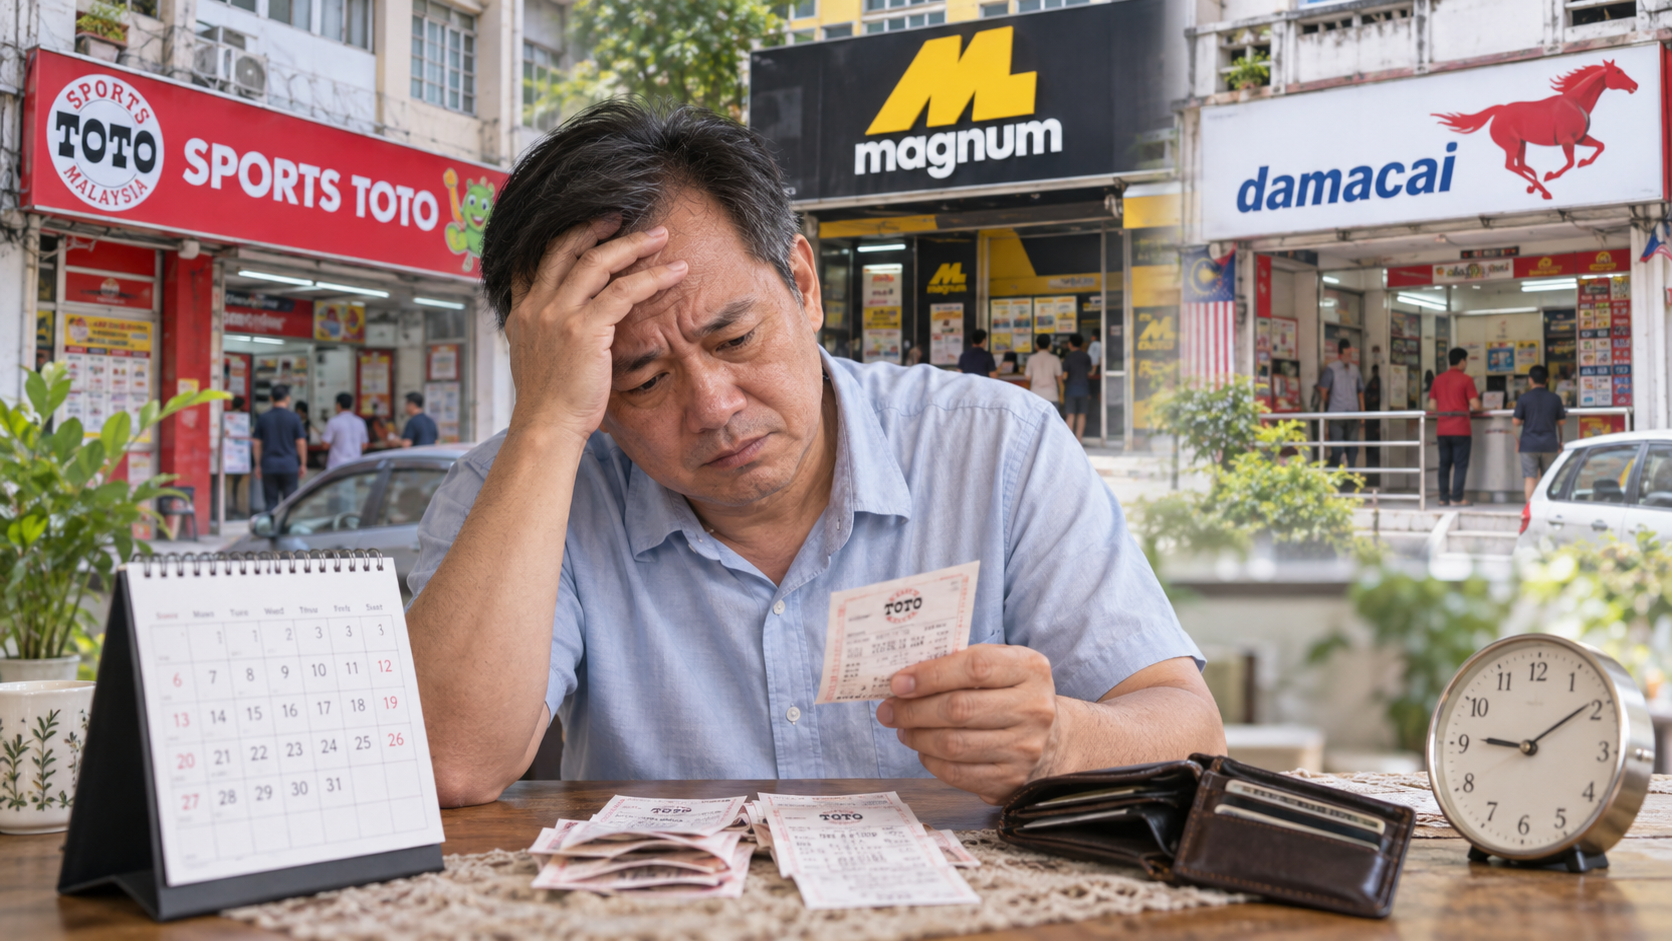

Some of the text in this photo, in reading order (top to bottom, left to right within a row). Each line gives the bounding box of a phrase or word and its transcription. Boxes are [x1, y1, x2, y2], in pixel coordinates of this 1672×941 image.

[66, 80, 150, 125] SPORTS
[56, 110, 157, 174] TOTO
[854, 117, 1063, 180] magnum
[63, 165, 148, 206] MALAYSIA
[182, 137, 439, 232] SPORTS TOTO
[1236, 141, 1458, 214] damacai
[884, 596, 922, 616] TOTO
[284, 627, 293, 642] 2
[314, 625, 324, 640] 3
[345, 624, 353, 638] 3
[377, 623, 385, 636] 3
[172, 659, 393, 688] 6 7 8 9 10 11 12
[1497, 671, 1512, 691] 11
[1529, 661, 1548, 682] 12
[1569, 671, 1576, 692] 1
[173, 695, 398, 728] 13 14 15 16 17 18 19
[1471, 697, 1489, 718] 10
[1589, 699, 1603, 721] 2
[177, 732, 405, 770] 20 21 22 23 24 25 26
[1458, 733, 1470, 754] 9
[1596, 740, 1610, 763] 3
[181, 776, 342, 811] 27 28 29 30 31
[1462, 773, 1475, 793] 8
[1582, 781, 1595, 803] 4
[819, 813, 863, 821] TOTO
[1486, 801, 1498, 822] 7
[1554, 807, 1567, 829] 5
[1517, 814, 1530, 835] 6
